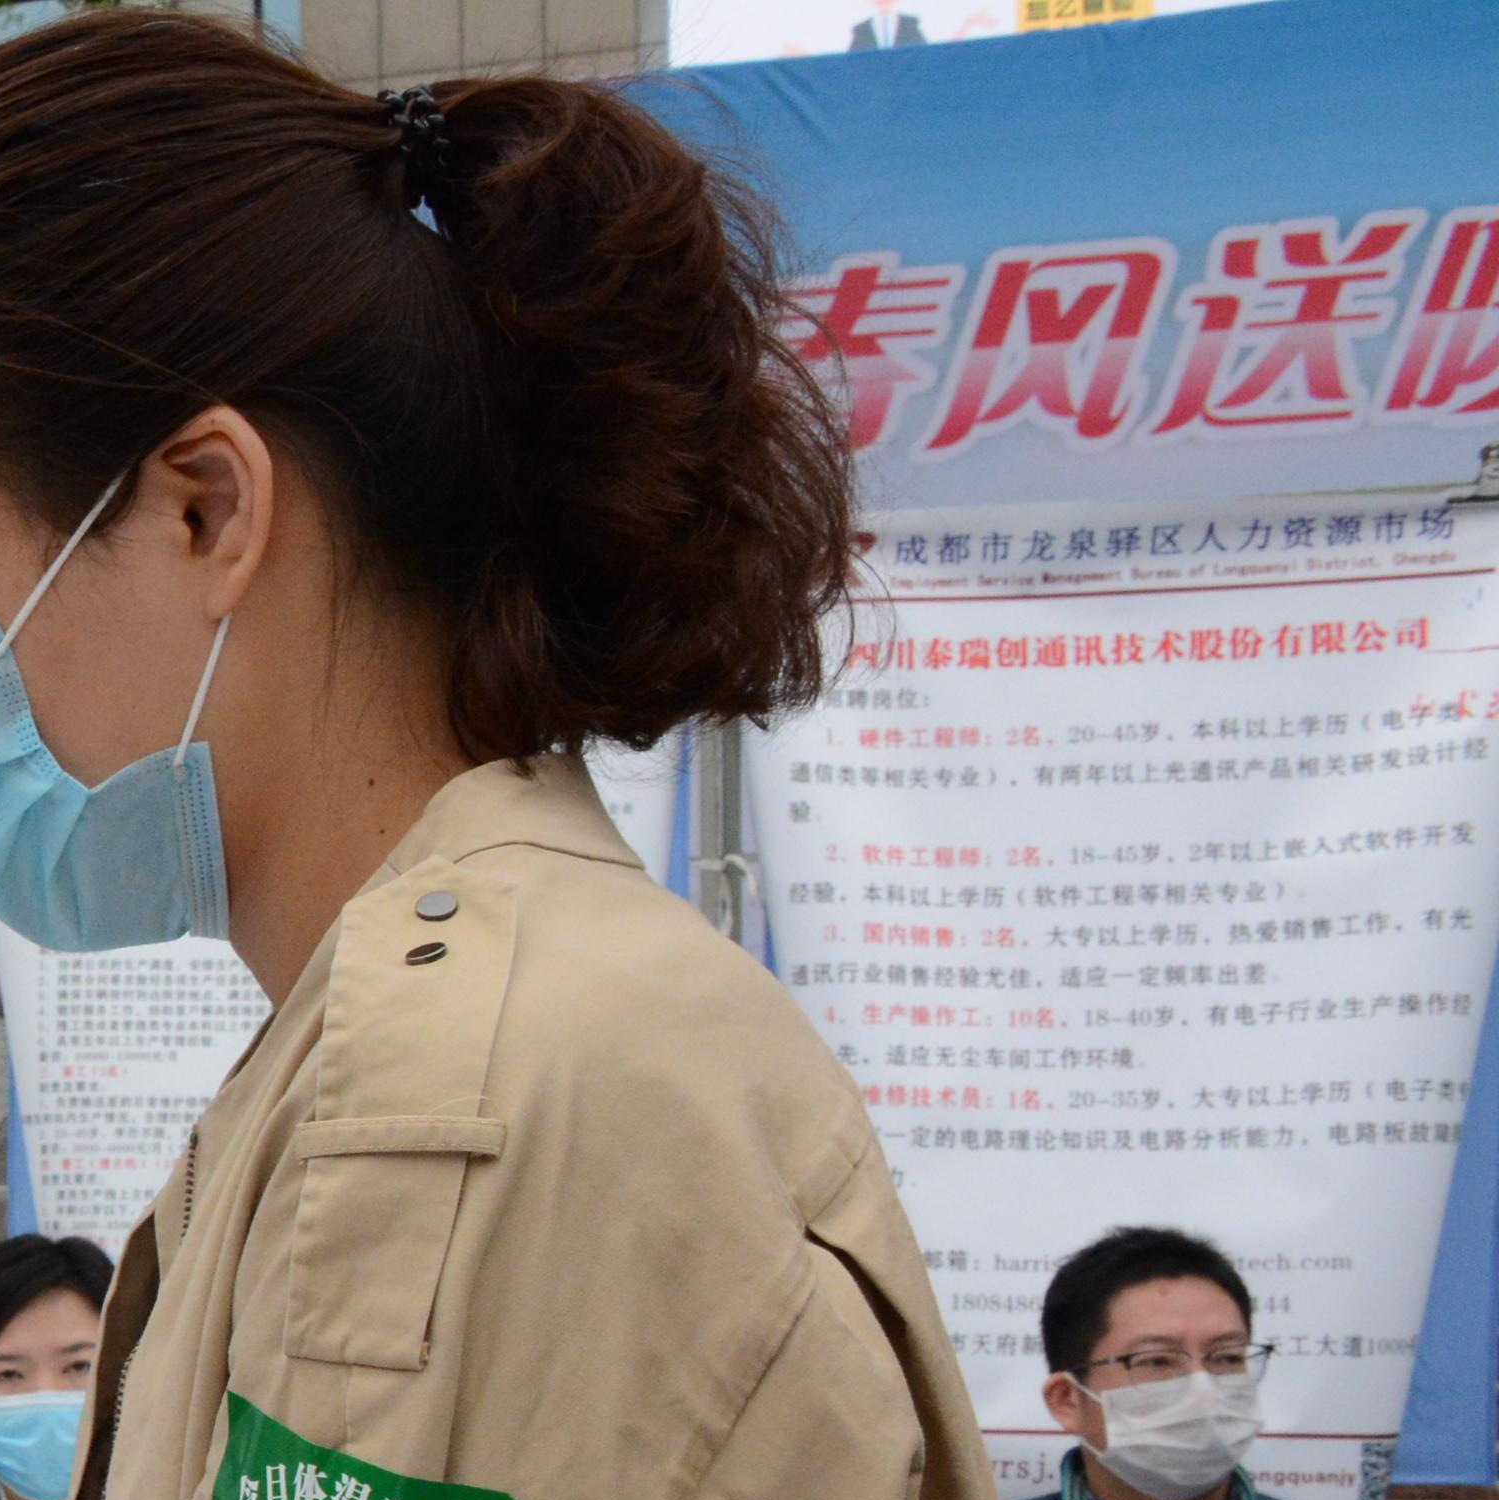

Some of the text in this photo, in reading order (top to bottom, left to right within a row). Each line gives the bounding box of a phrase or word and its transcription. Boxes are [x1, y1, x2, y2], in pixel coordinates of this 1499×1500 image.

[895, 506, 1456, 566] 成都市龙泉驿区人力资源市场
[977, 572, 1034, 588] Service
[1131, 566, 1181, 581] Bureau
[1189, 564, 1206, 578] of
[847, 616, 1430, 671] 四川泰瑞创通讯技术股份有限公司
[1231, 1253, 1353, 1272] tech.com
